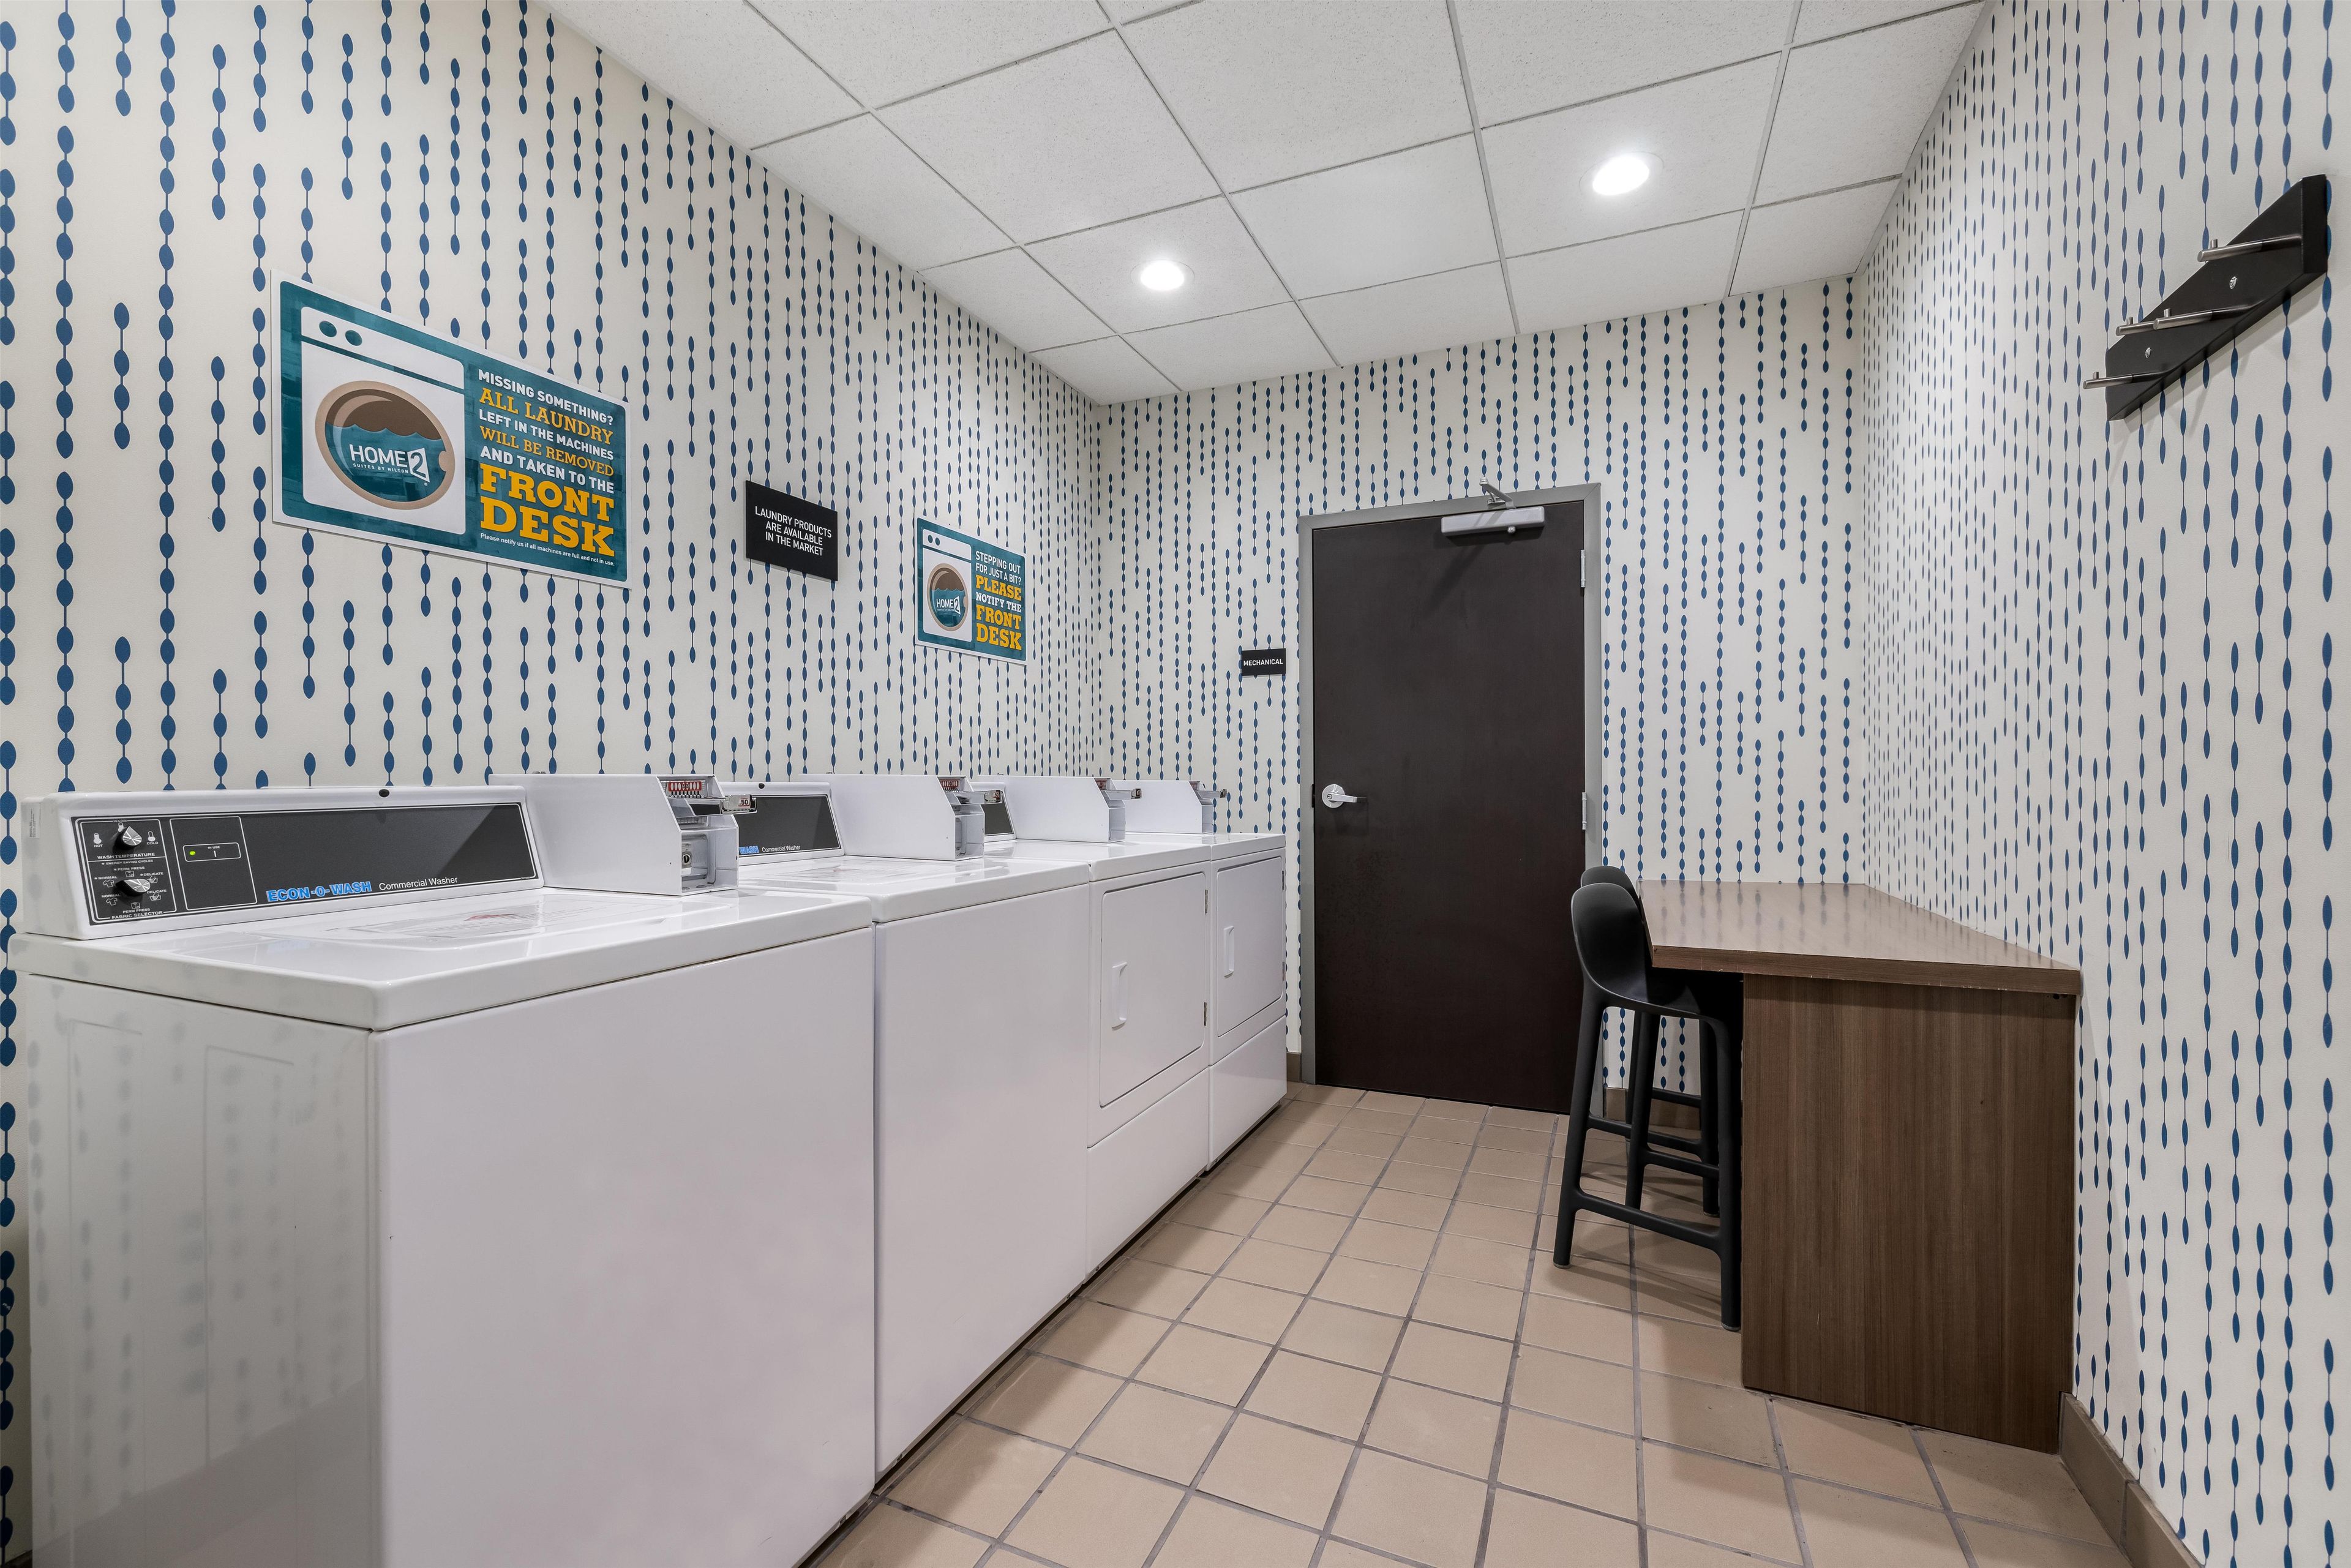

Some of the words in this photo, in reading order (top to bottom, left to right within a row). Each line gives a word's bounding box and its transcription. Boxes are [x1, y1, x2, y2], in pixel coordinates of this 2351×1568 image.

[478, 369, 534, 398] MISSING
[537, 390, 613, 425] SOMETHING?
[479, 387, 519, 415] ALL
[525, 402, 613, 445] LAUNDRY
[479, 408, 511, 428] LEFT
[514, 420, 527, 433] IN
[530, 425, 554, 442] THE
[557, 433, 614, 460] MACHINES
[479, 426, 519, 449] WILL
[523, 439, 542, 456] BE
[546, 446, 614, 476] REMOVED
[480, 445, 513, 465] AND
[517, 455, 565, 481] TAKEN
[568, 470, 585, 486] TO
[588, 476, 614, 494] THE
[480, 463, 614, 522] FRONT
[480, 496, 615, 557] DESK
[755, 506, 792, 525] LAUNDRY
[794, 518, 832, 538] PRODUCTS
[765, 521, 782, 533] ARE
[783, 526, 823, 546] AVAILABLE
[480, 533, 500, 542] Please
[537, 546, 562, 555] machines
[765, 531, 774, 542] IN
[776, 534, 791, 547] THE
[793, 539, 823, 556] MARKET
[975, 550, 1007, 569] STEPPING
[1008, 562, 1021, 574] OUT
[976, 562, 988, 574] FOR
[989, 567, 1003, 579] JUST
[1003, 572, 1008, 581] A
[1009, 573, 1021, 585] BIT?
[975, 574, 1022, 601] PLEASE
[975, 591, 1005, 608] NOTIFY
[1006, 601, 1022, 613] THE
[975, 604, 1022, 630] FRONT
[976, 623, 1022, 650] DESK
[379, 878, 427, 891] Commercial
[428, 876, 458, 886] Washer
